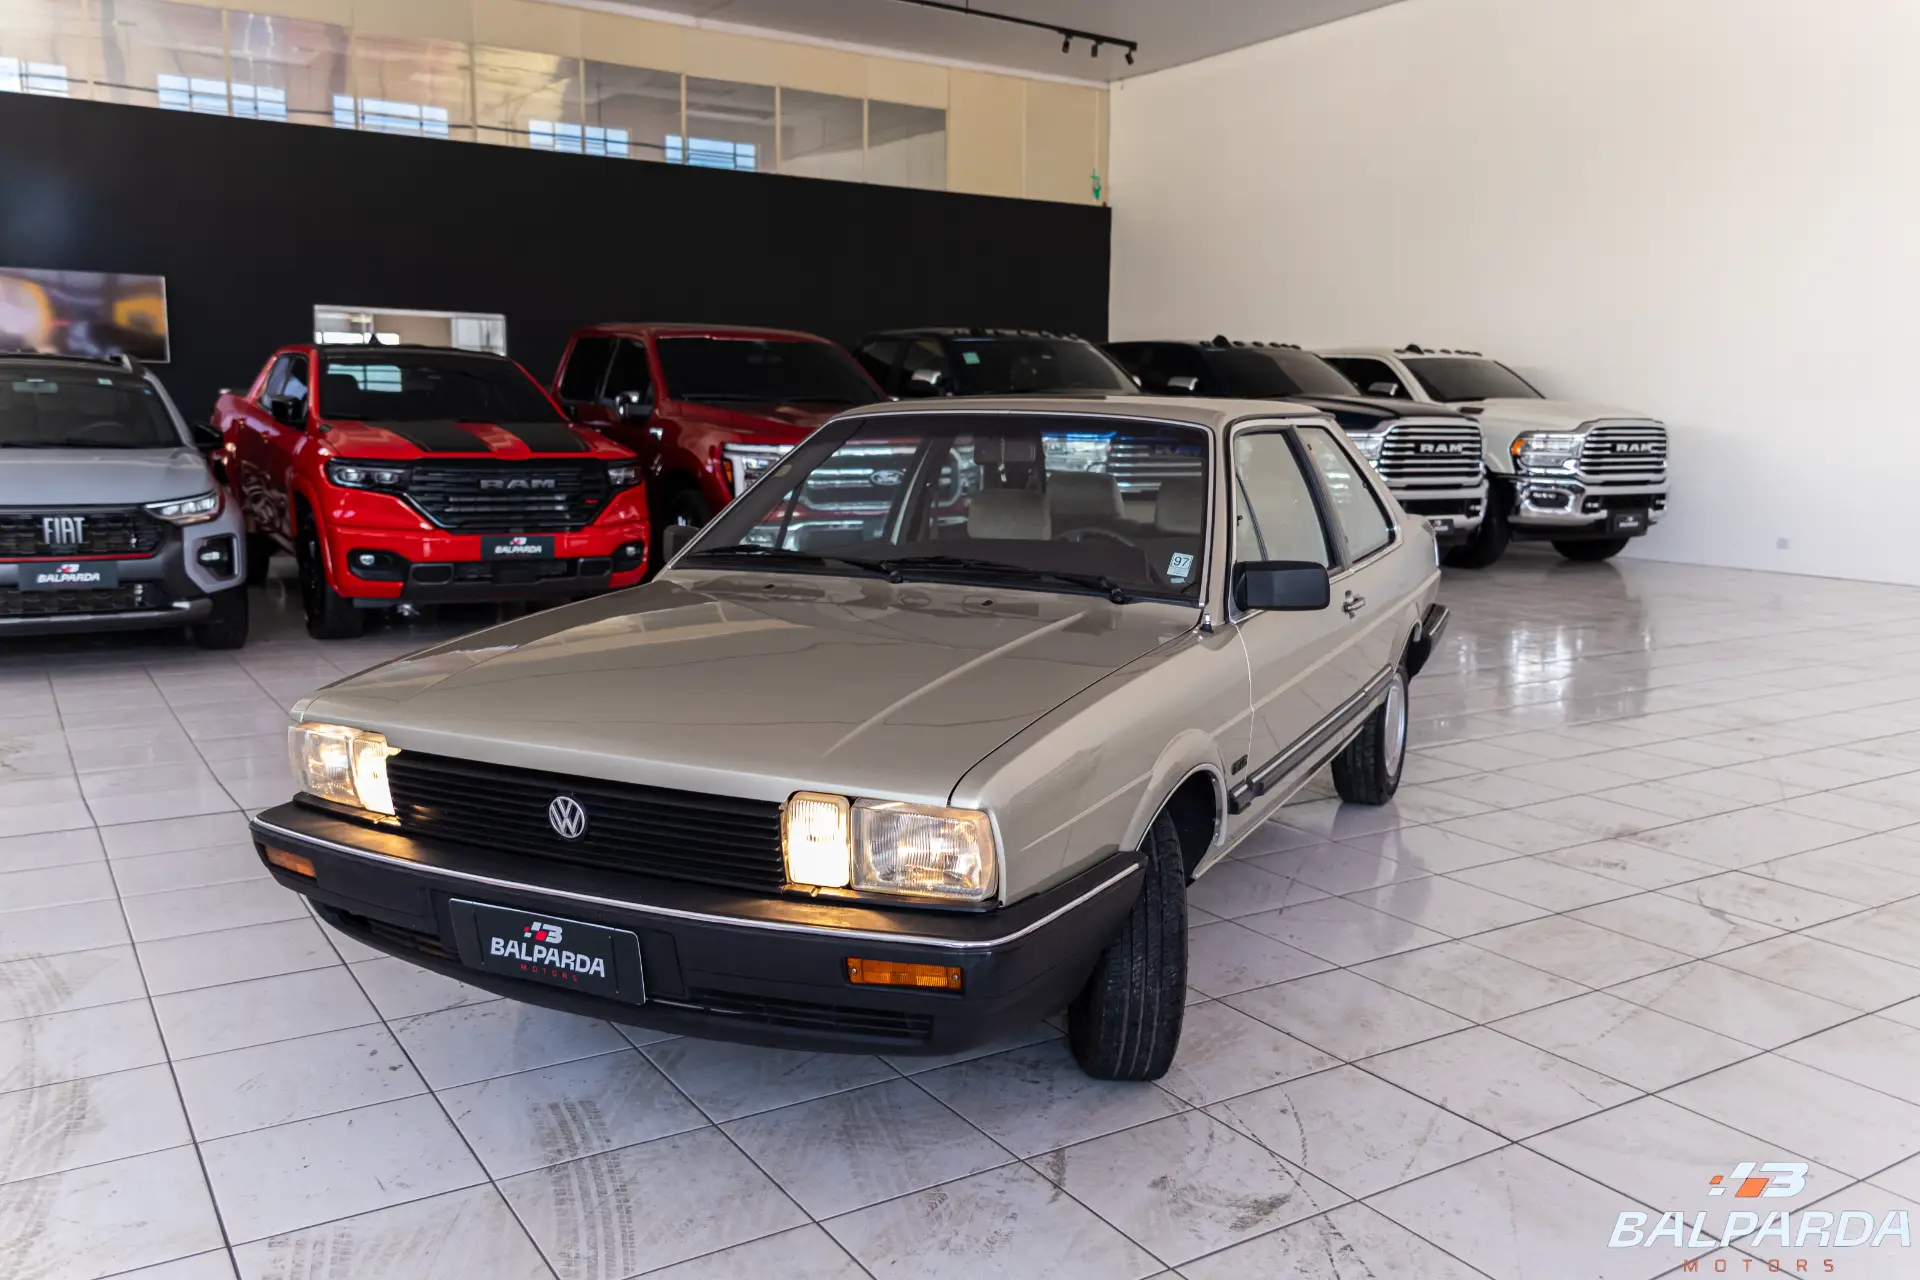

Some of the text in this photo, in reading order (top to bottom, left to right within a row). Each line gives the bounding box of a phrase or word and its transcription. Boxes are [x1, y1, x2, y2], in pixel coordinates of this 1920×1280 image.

[1420, 443, 1463, 453] RAM
[1616, 443, 1653, 453] RAM
[480, 479, 555, 489] RAM
[42, 517, 85, 544] FIAT
[494, 545, 542, 555] BALPARDA
[1173, 556, 1190, 567] 97
[36, 572, 101, 583] BALPARDA
[490, 936, 605, 978] BALPARDA
[520, 963, 578, 982] MOTORS
